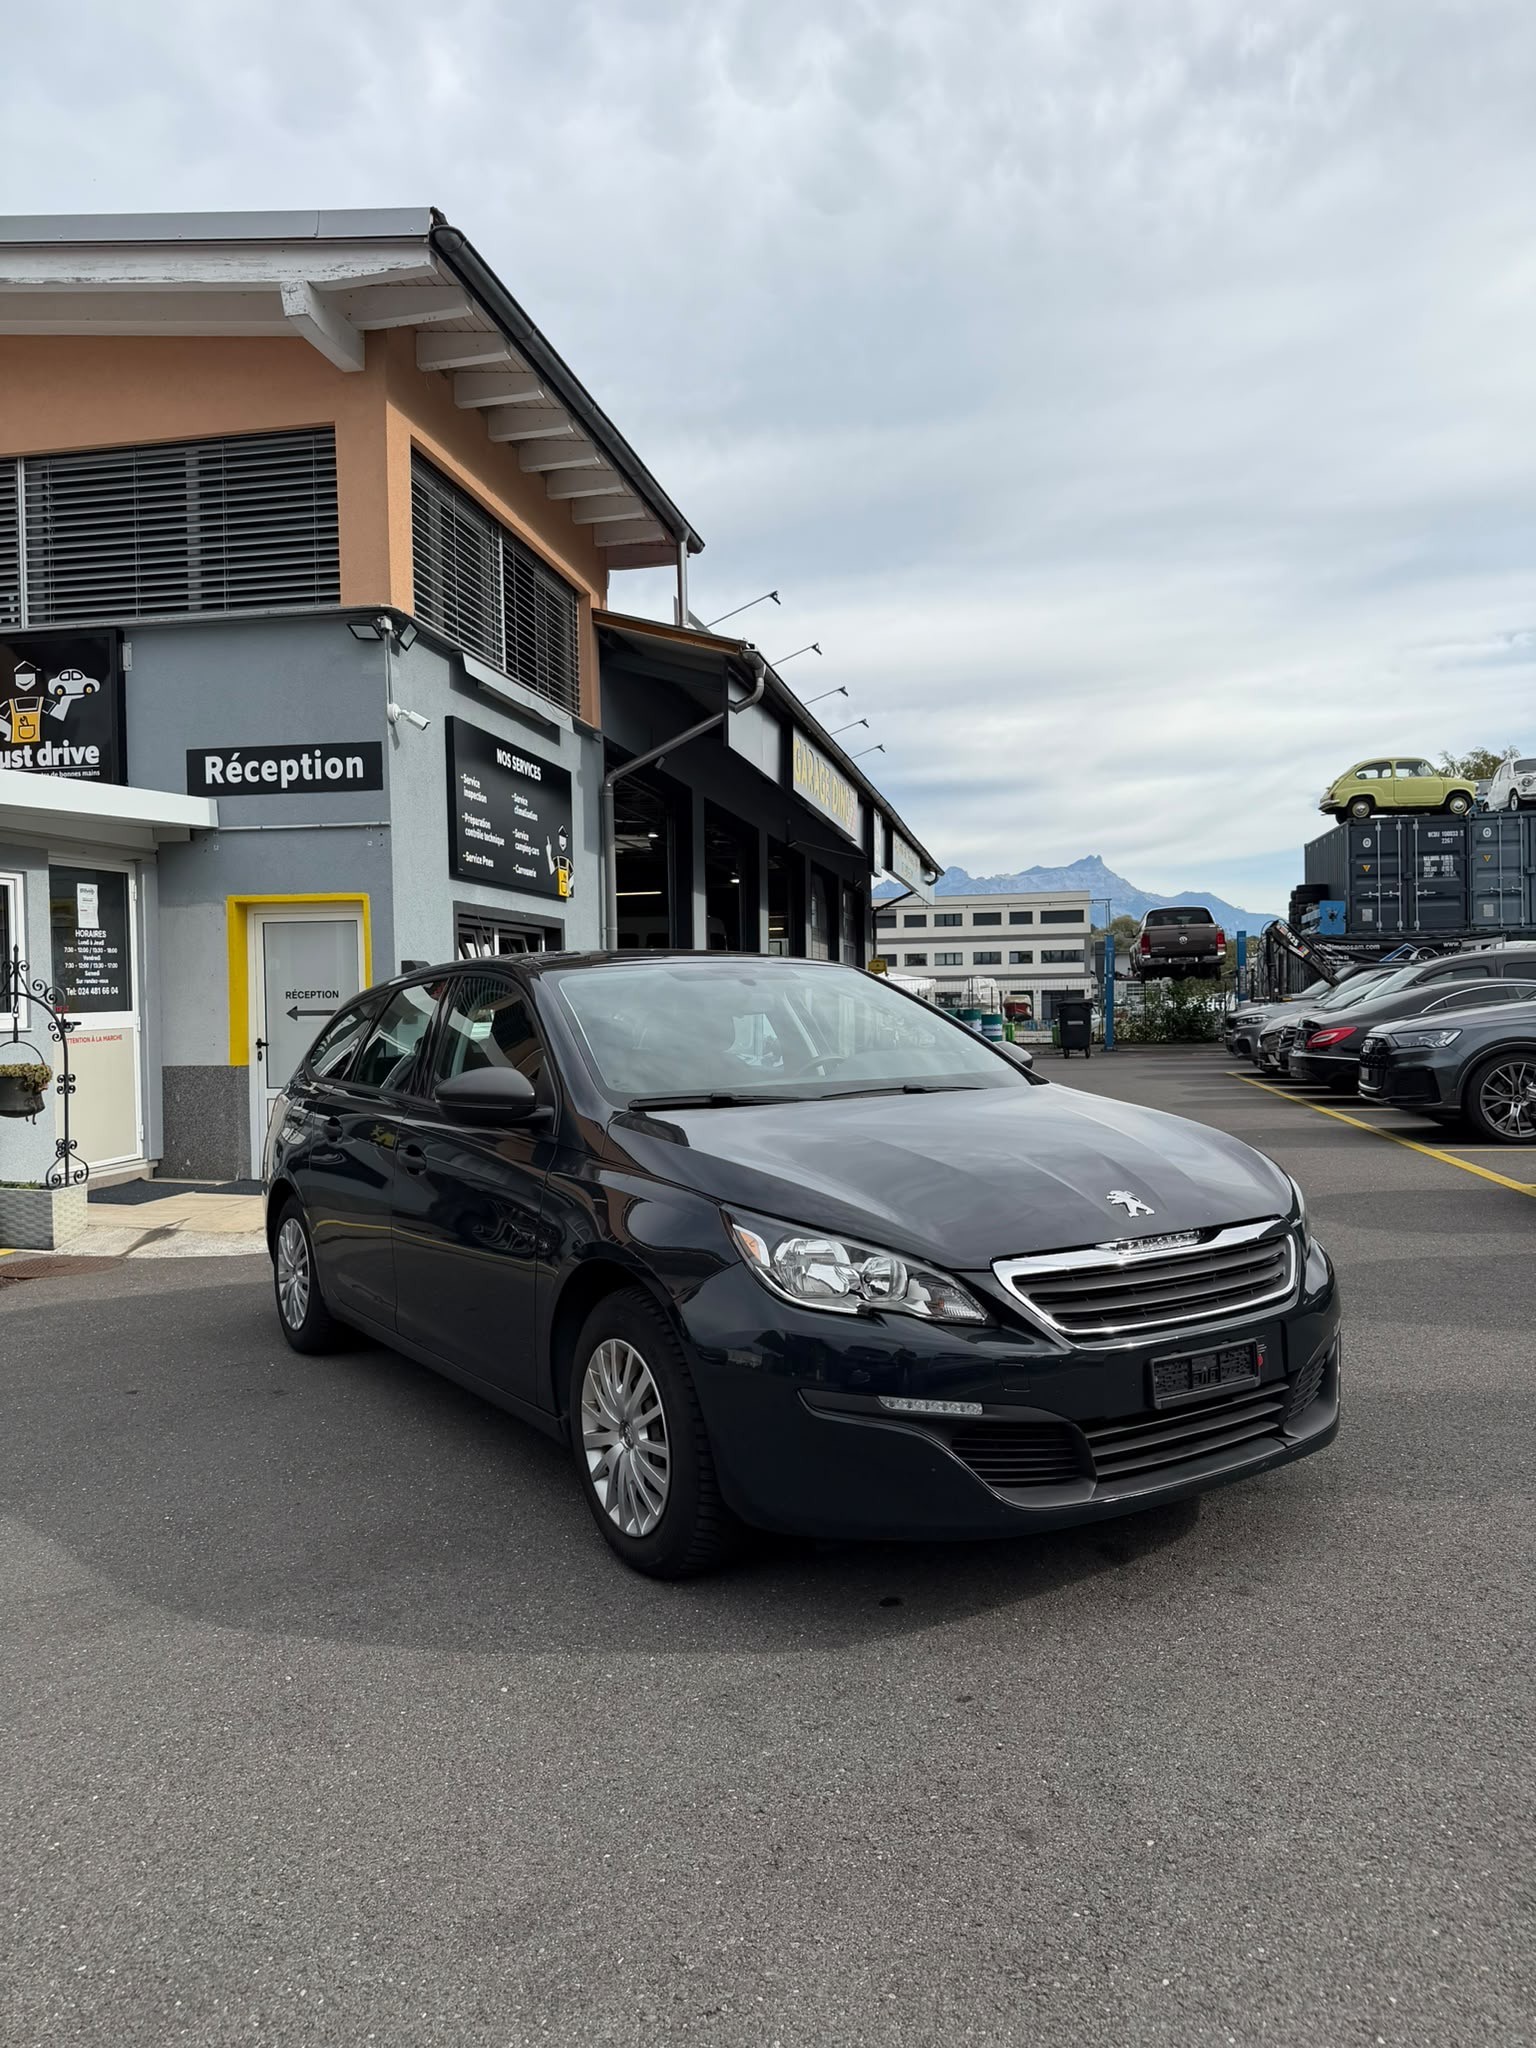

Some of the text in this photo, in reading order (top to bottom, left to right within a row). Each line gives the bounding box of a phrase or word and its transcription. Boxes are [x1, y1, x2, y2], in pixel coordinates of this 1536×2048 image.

[37, 740, 100, 766] drive
[204, 749, 364, 789] Réception
[496, 747, 541, 781] NOS SERVICES
[794, 737, 830, 807] GARAGE
[463, 786, 487, 803] inspection
[75, 929, 107, 938] HORAIRES
[77, 986, 90, 996] 024
[90, 986, 101, 995] 481
[101, 986, 111, 995] 66
[110, 986, 119, 995] 04
[285, 989, 340, 1000] RÉCEPTION
[66, 1036, 91, 1044] TTENTION
[96, 1035, 103, 1043] LA
[103, 1034, 123, 1042] MARCHE
